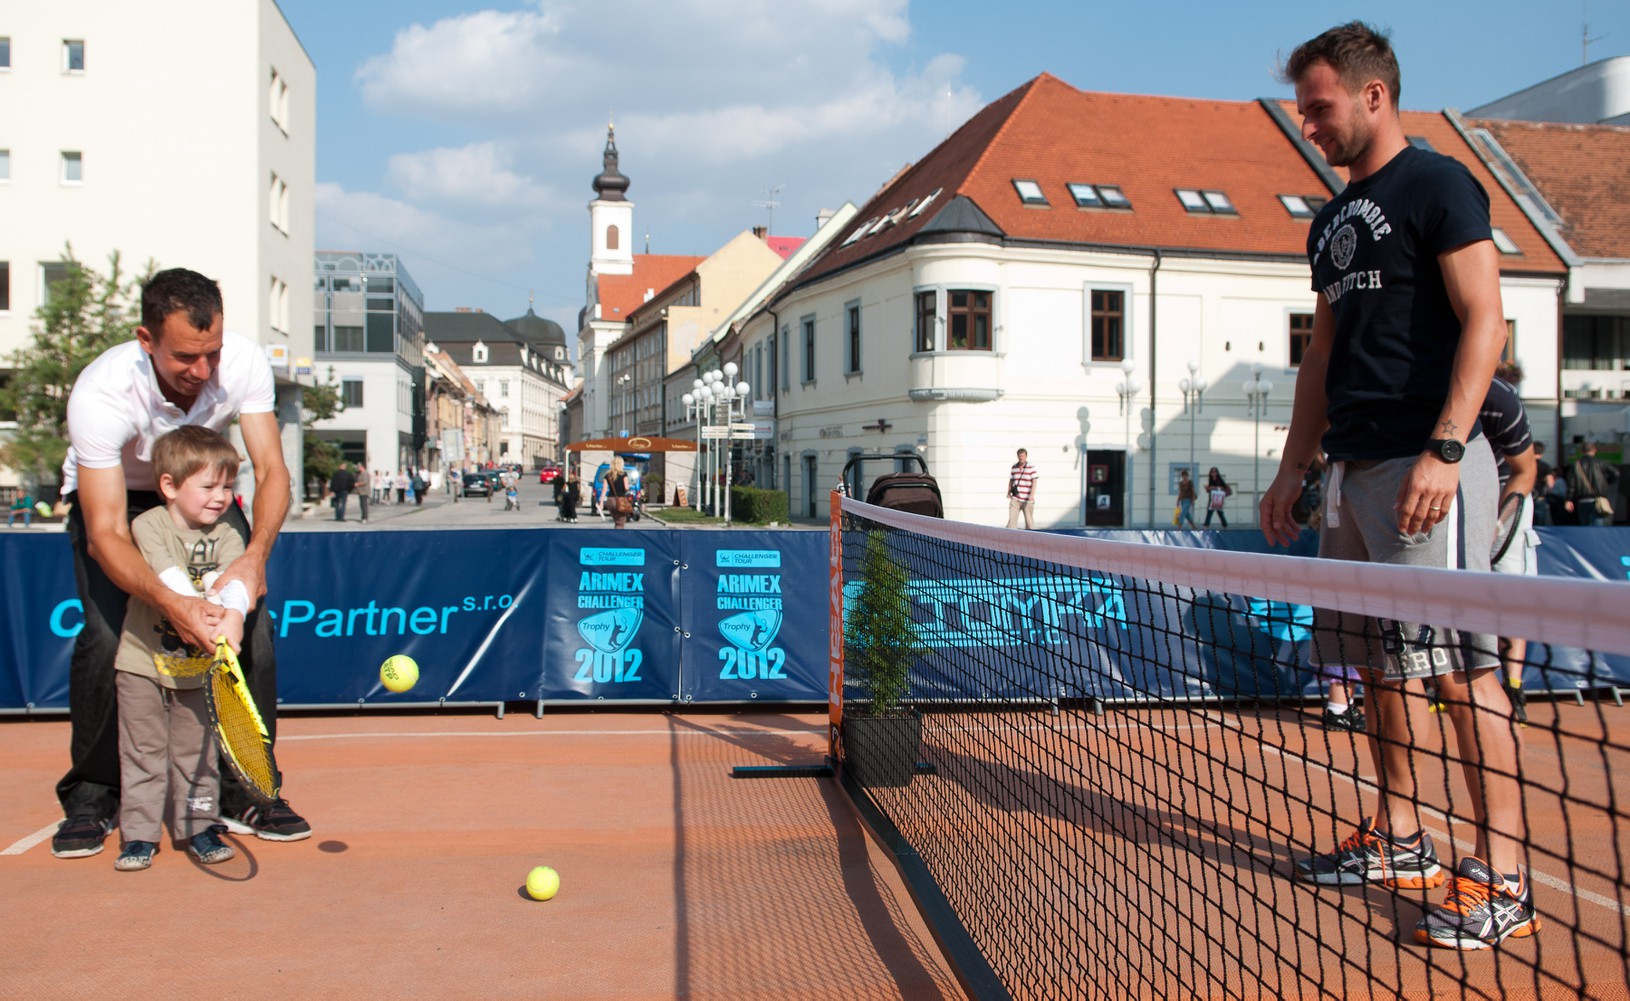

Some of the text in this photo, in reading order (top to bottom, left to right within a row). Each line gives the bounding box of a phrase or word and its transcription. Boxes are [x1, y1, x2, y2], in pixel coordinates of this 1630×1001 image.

[1342, 271, 1382, 293] FITCH
[579, 572, 644, 591] ARIMEX
[717, 575, 782, 593] ARIMEX
[462, 594, 519, 611] s.r.o.
[578, 595, 644, 609] CHALLENGER
[717, 597, 783, 610] CHALLENGER
[829, 521, 841, 707] HEAD
[582, 622, 611, 632] Trophy
[723, 622, 751, 632] Trophy
[574, 648, 643, 683] 2012
[719, 647, 787, 679] 2012
